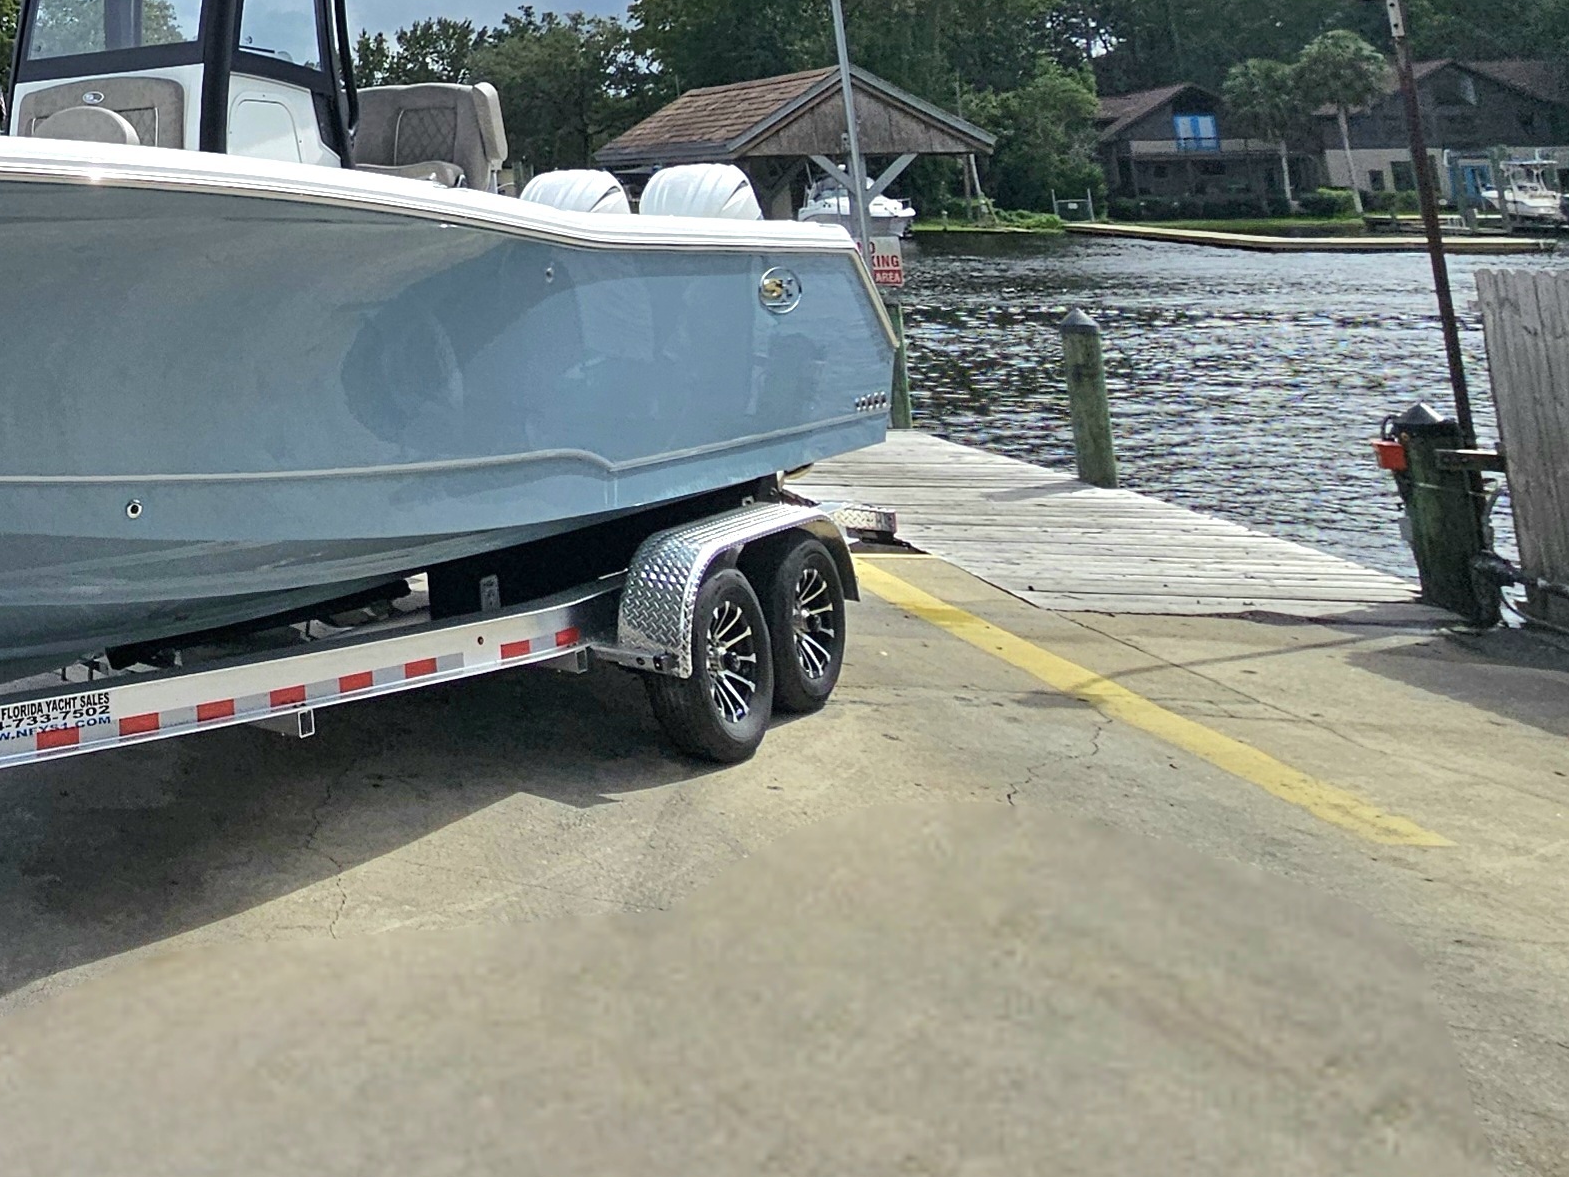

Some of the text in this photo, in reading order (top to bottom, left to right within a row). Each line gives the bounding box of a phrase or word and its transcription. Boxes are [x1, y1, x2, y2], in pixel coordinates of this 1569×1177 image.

[1, 702, 44, 720] FLORIDA
[46, 696, 79, 714] YACHT
[80, 691, 110, 706] SALES
